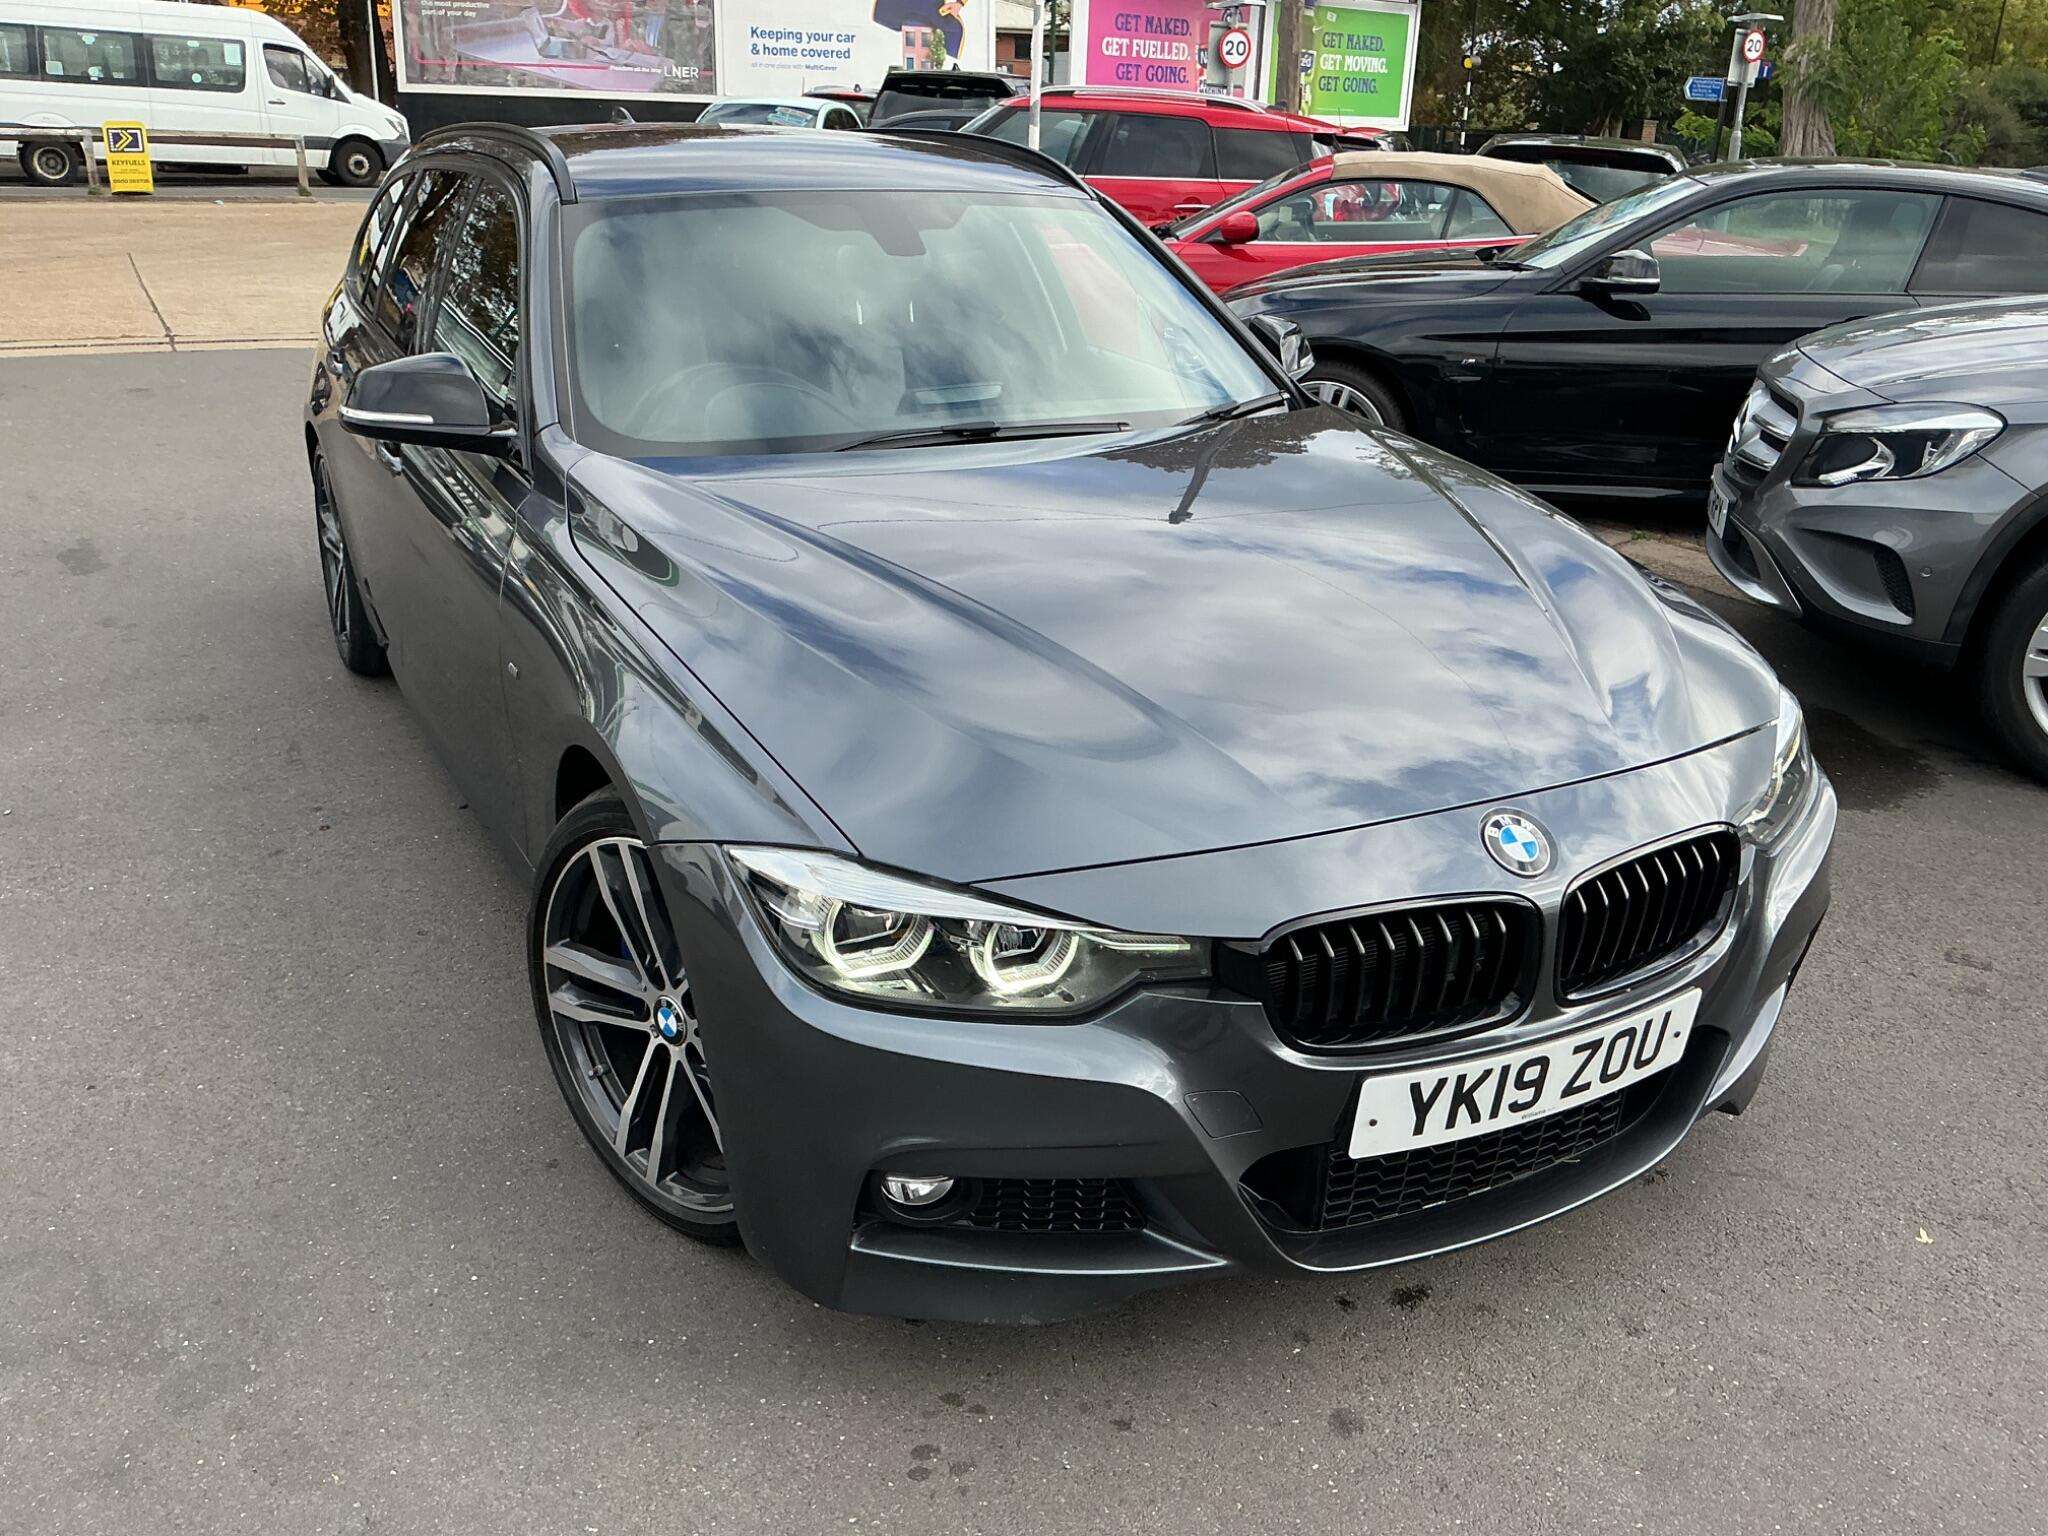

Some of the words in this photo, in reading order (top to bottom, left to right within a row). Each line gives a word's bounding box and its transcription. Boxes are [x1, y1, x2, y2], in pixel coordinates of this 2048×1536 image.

[1114, 12, 1141, 32] GET
[1144, 15, 1192, 36] NAKED.
[750, 26, 803, 44] Keeping
[805, 32, 834, 44] your
[836, 33, 857, 43] car
[1322, 32, 1345, 49] GET
[1346, 34, 1385, 52] NAKED.
[750, 43, 761, 56] &
[763, 43, 799, 57] home
[800, 47, 852, 59] covered
[1101, 36, 1130, 56] GET
[1131, 38, 1191, 61] FUELLED.
[1225, 40, 1247, 56] 20
[1747, 38, 1762, 53] 20
[664, 65, 699, 79] LNER
[1320, 53, 1343, 71] GET
[1343, 55, 1389, 74] MOVING.
[1115, 63, 1142, 82] GET
[1145, 64, 1190, 84] GOING.
[1318, 75, 1341, 92] GET
[1342, 76, 1379, 94] GOING.
[1409, 1055, 1551, 1137] YK19
[1560, 1010, 1673, 1099] ZOU
